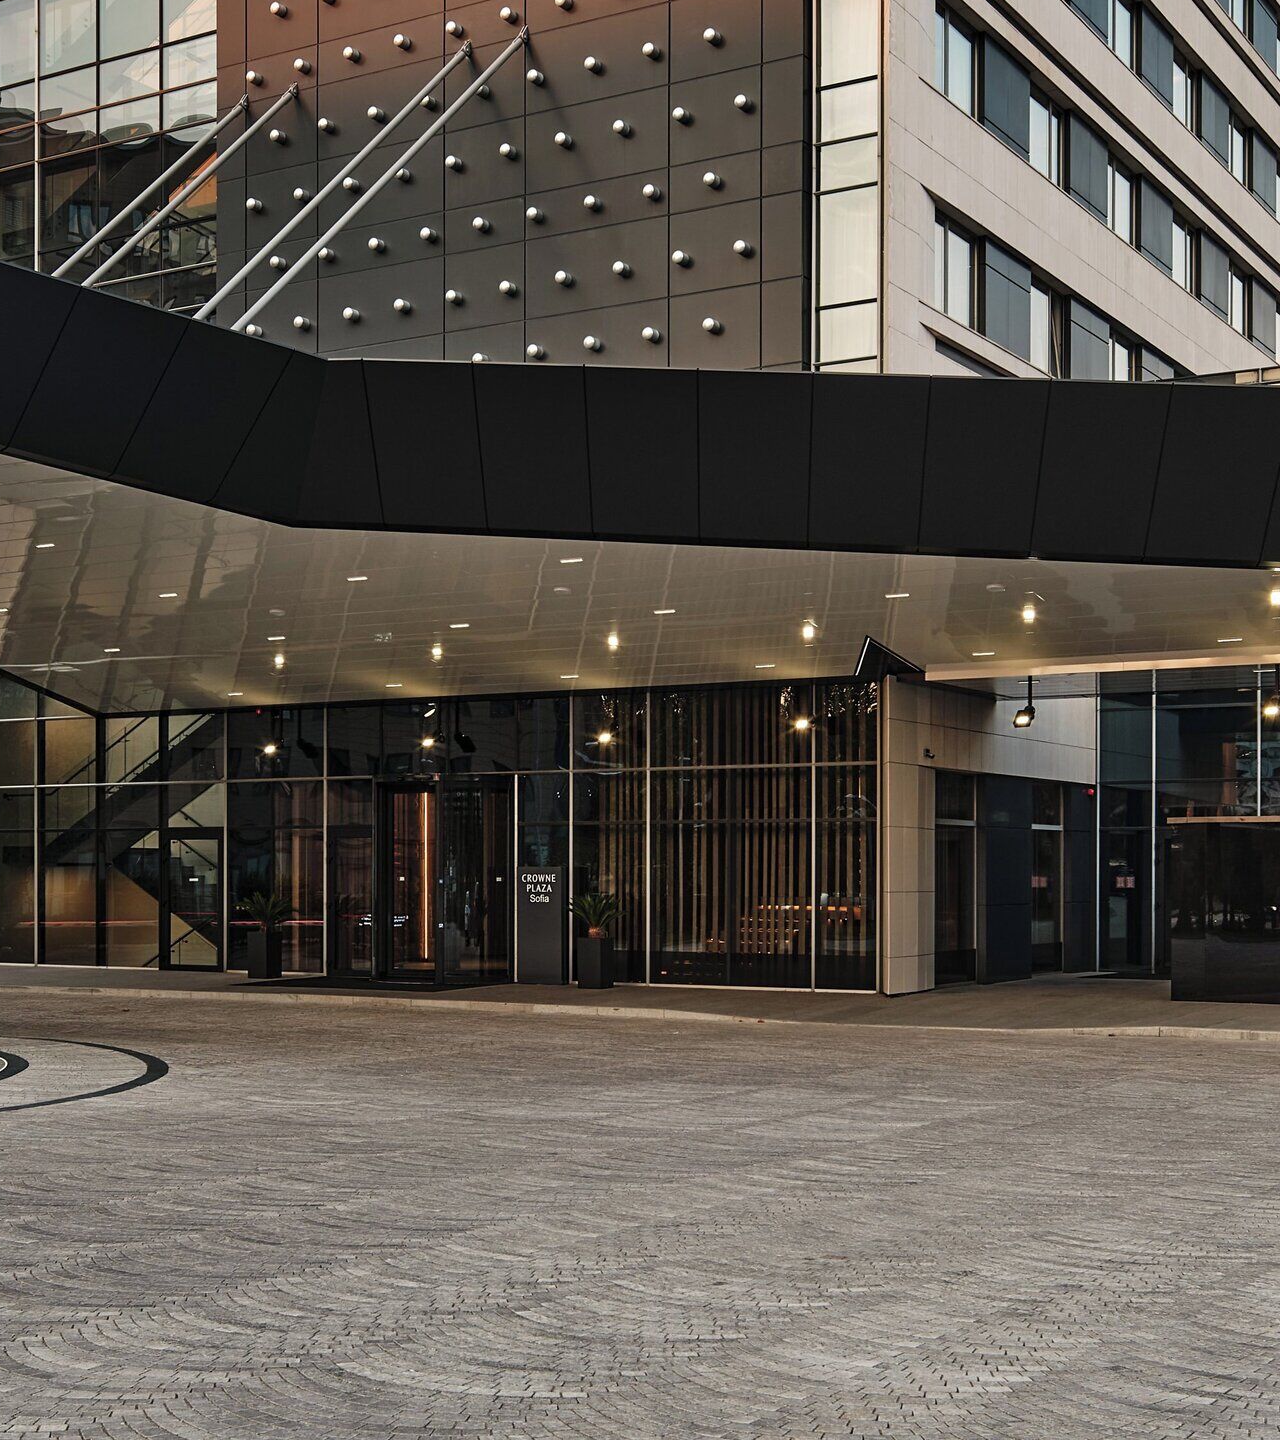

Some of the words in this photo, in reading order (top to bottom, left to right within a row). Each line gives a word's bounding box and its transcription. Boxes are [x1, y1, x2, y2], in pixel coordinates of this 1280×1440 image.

[521, 873, 556, 883] CROWNE
[526, 883, 552, 893] PLAZA
[529, 894, 550, 903] Sofia
